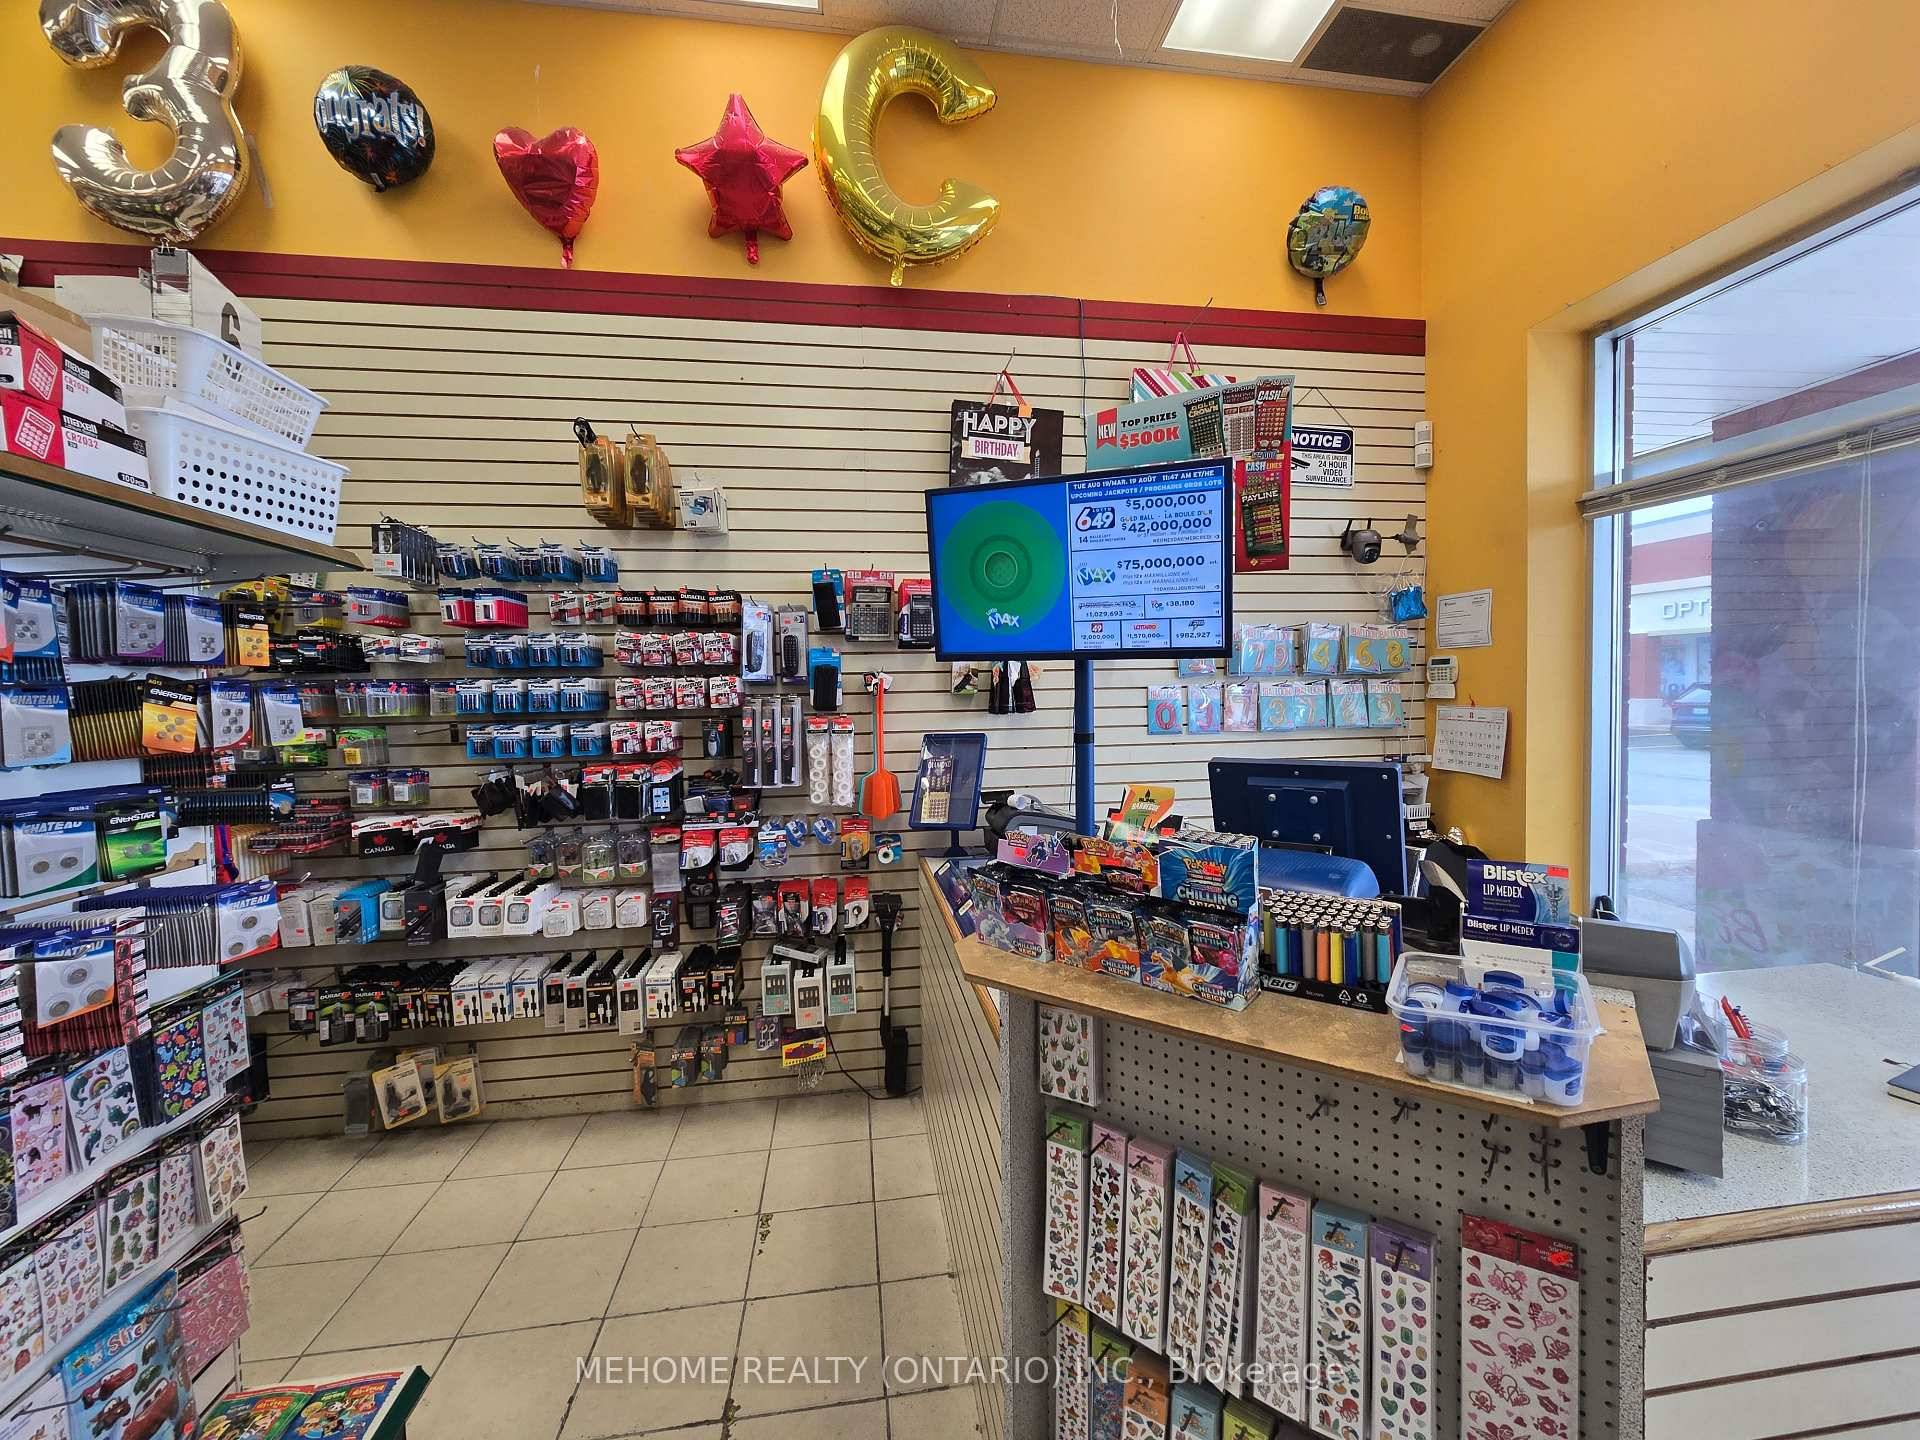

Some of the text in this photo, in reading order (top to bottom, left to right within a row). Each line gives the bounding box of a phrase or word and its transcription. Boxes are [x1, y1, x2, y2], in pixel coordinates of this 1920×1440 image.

[1257, 389, 1282, 401] CASH
[1121, 418, 1141, 428] TOP
[1144, 411, 1177, 425] PRIZES
[1188, 405, 1219, 419] CROWN
[63, 416, 97, 437] maxell
[962, 411, 1036, 443] HAPPY
[1098, 422, 1116, 440] NEW
[65, 431, 98, 449] CR2032
[1119, 426, 1180, 450] $500K
[1291, 432, 1343, 448] NOTICE
[974, 439, 1018, 458] BIRTHDAY
[1246, 462, 1266, 473] CASH
[1318, 460, 1348, 470] 24 HOUR
[1322, 468, 1343, 477] VIDEO
[1073, 482, 1086, 490] TUE
[1305, 475, 1348, 484] SURVEILLANCE
[1071, 492, 1102, 500] UPCOMING
[1104, 488, 1138, 496] JACKPOTS
[1204, 479, 1222, 487] LOTS
[1242, 490, 1279, 504] PAYLINE
[1125, 494, 1207, 511] $5,000,000
[1139, 514, 1155, 522] BALL
[1175, 510, 1195, 518] BOULE
[1121, 517, 1212, 534] $42,000,000
[1117, 555, 1205, 571] $75,000,000
[680, 593, 706, 601] DURACELL
[150, 688, 194, 702] ENERSTAR
[364, 846, 395, 855] CANADA
[1483, 864, 1548, 888] Blistex
[1177, 885, 1238, 909] CHILLING
[1483, 884, 1523, 899] LIP MEDEX
[1193, 928, 1221, 940] REIGN
[1467, 919, 1498, 932] Blistex
[1500, 923, 1511, 933] LIP
[1512, 926, 1535, 937] MEDEX
[1012, 938, 1042, 953] CHILLING
[1101, 960, 1137, 974] CHILLING
[1108, 967, 1130, 978] REIGN
[1192, 983, 1235, 999] CHILLING
[1271, 979, 1297, 991] BIC
[1201, 992, 1226, 1004] REIGN
